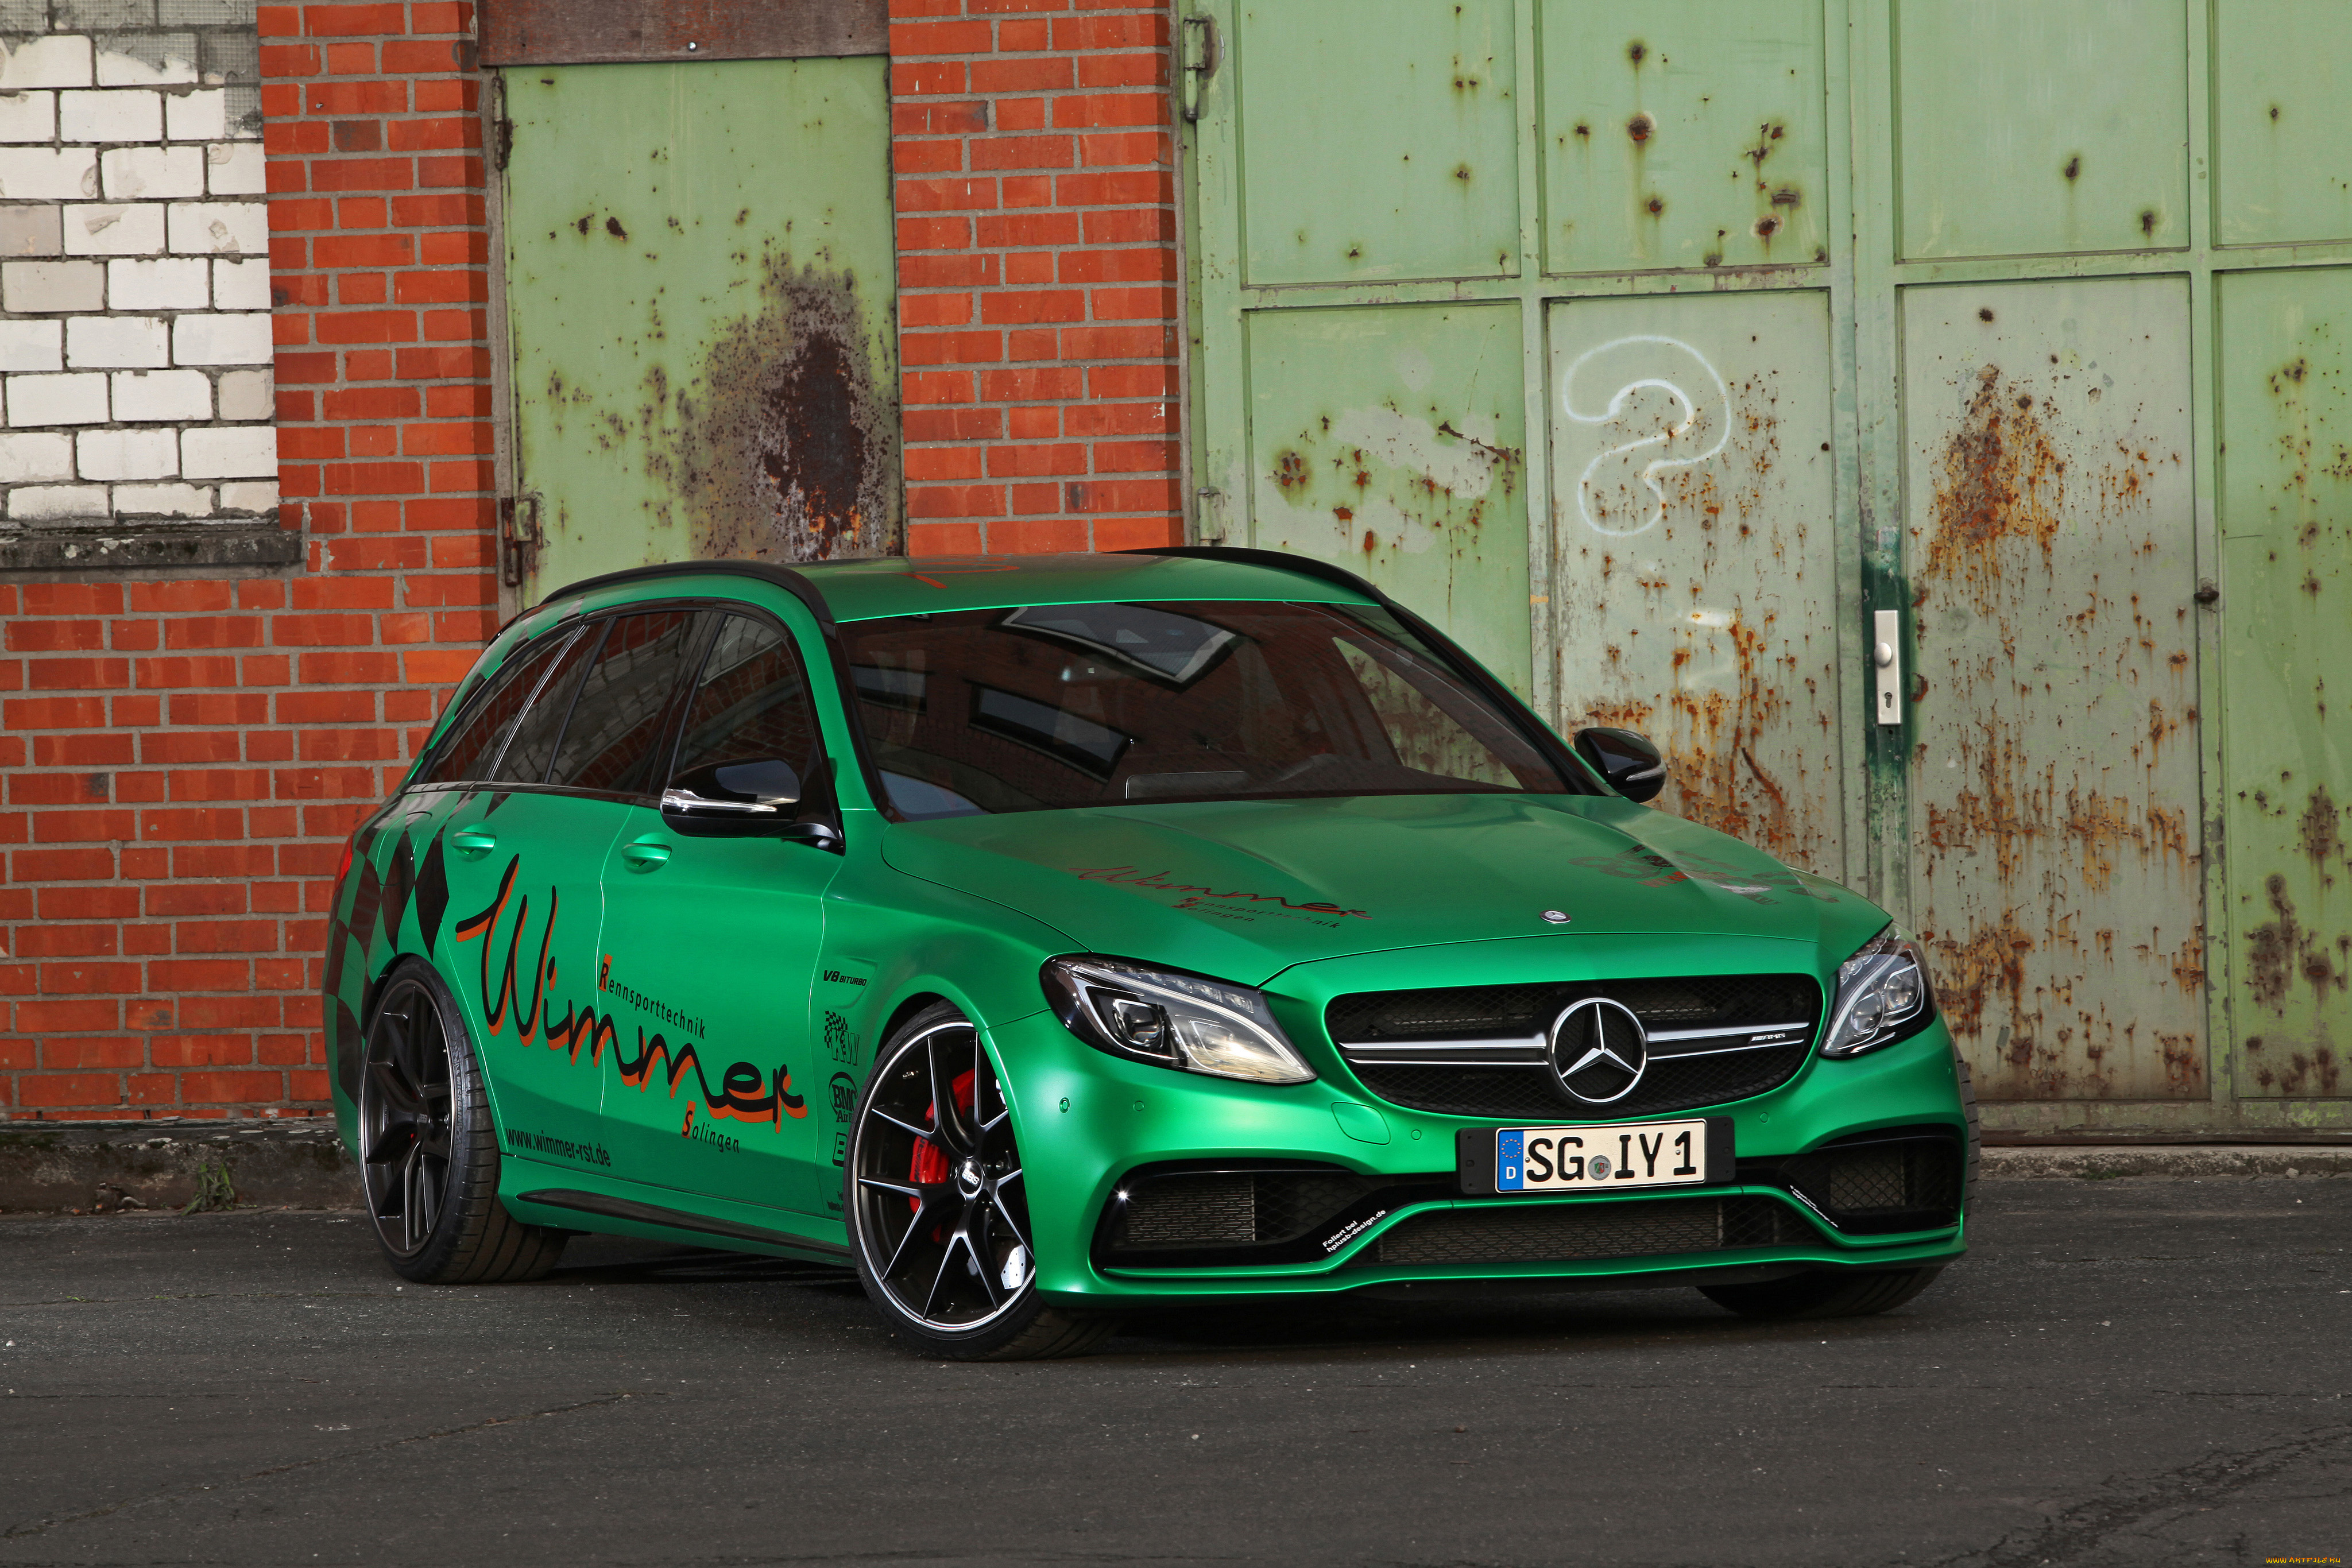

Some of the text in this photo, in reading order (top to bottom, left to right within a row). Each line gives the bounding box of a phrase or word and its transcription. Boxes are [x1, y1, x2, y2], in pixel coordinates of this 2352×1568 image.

[1069, 866, 1373, 920] Wimmer
[455, 853, 807, 1133] Wimmer
[598, 956, 705, 1040] Rennsporttechnik
[823, 970, 867, 986] V8 BITURBO
[830, 1027, 860, 1066] KW
[831, 1083, 858, 1112] BMC
[836, 1110, 848, 1122] Air
[505, 1127, 612, 1167] www.wimmer-rst.de
[681, 1102, 740, 1153] Solingen
[1506, 1166, 1517, 1179] D
[1526, 1130, 1697, 1182] SG IY 1
[962, 1167, 980, 1186] BBS
[1326, 1210, 1386, 1252] hplusb-design.de
